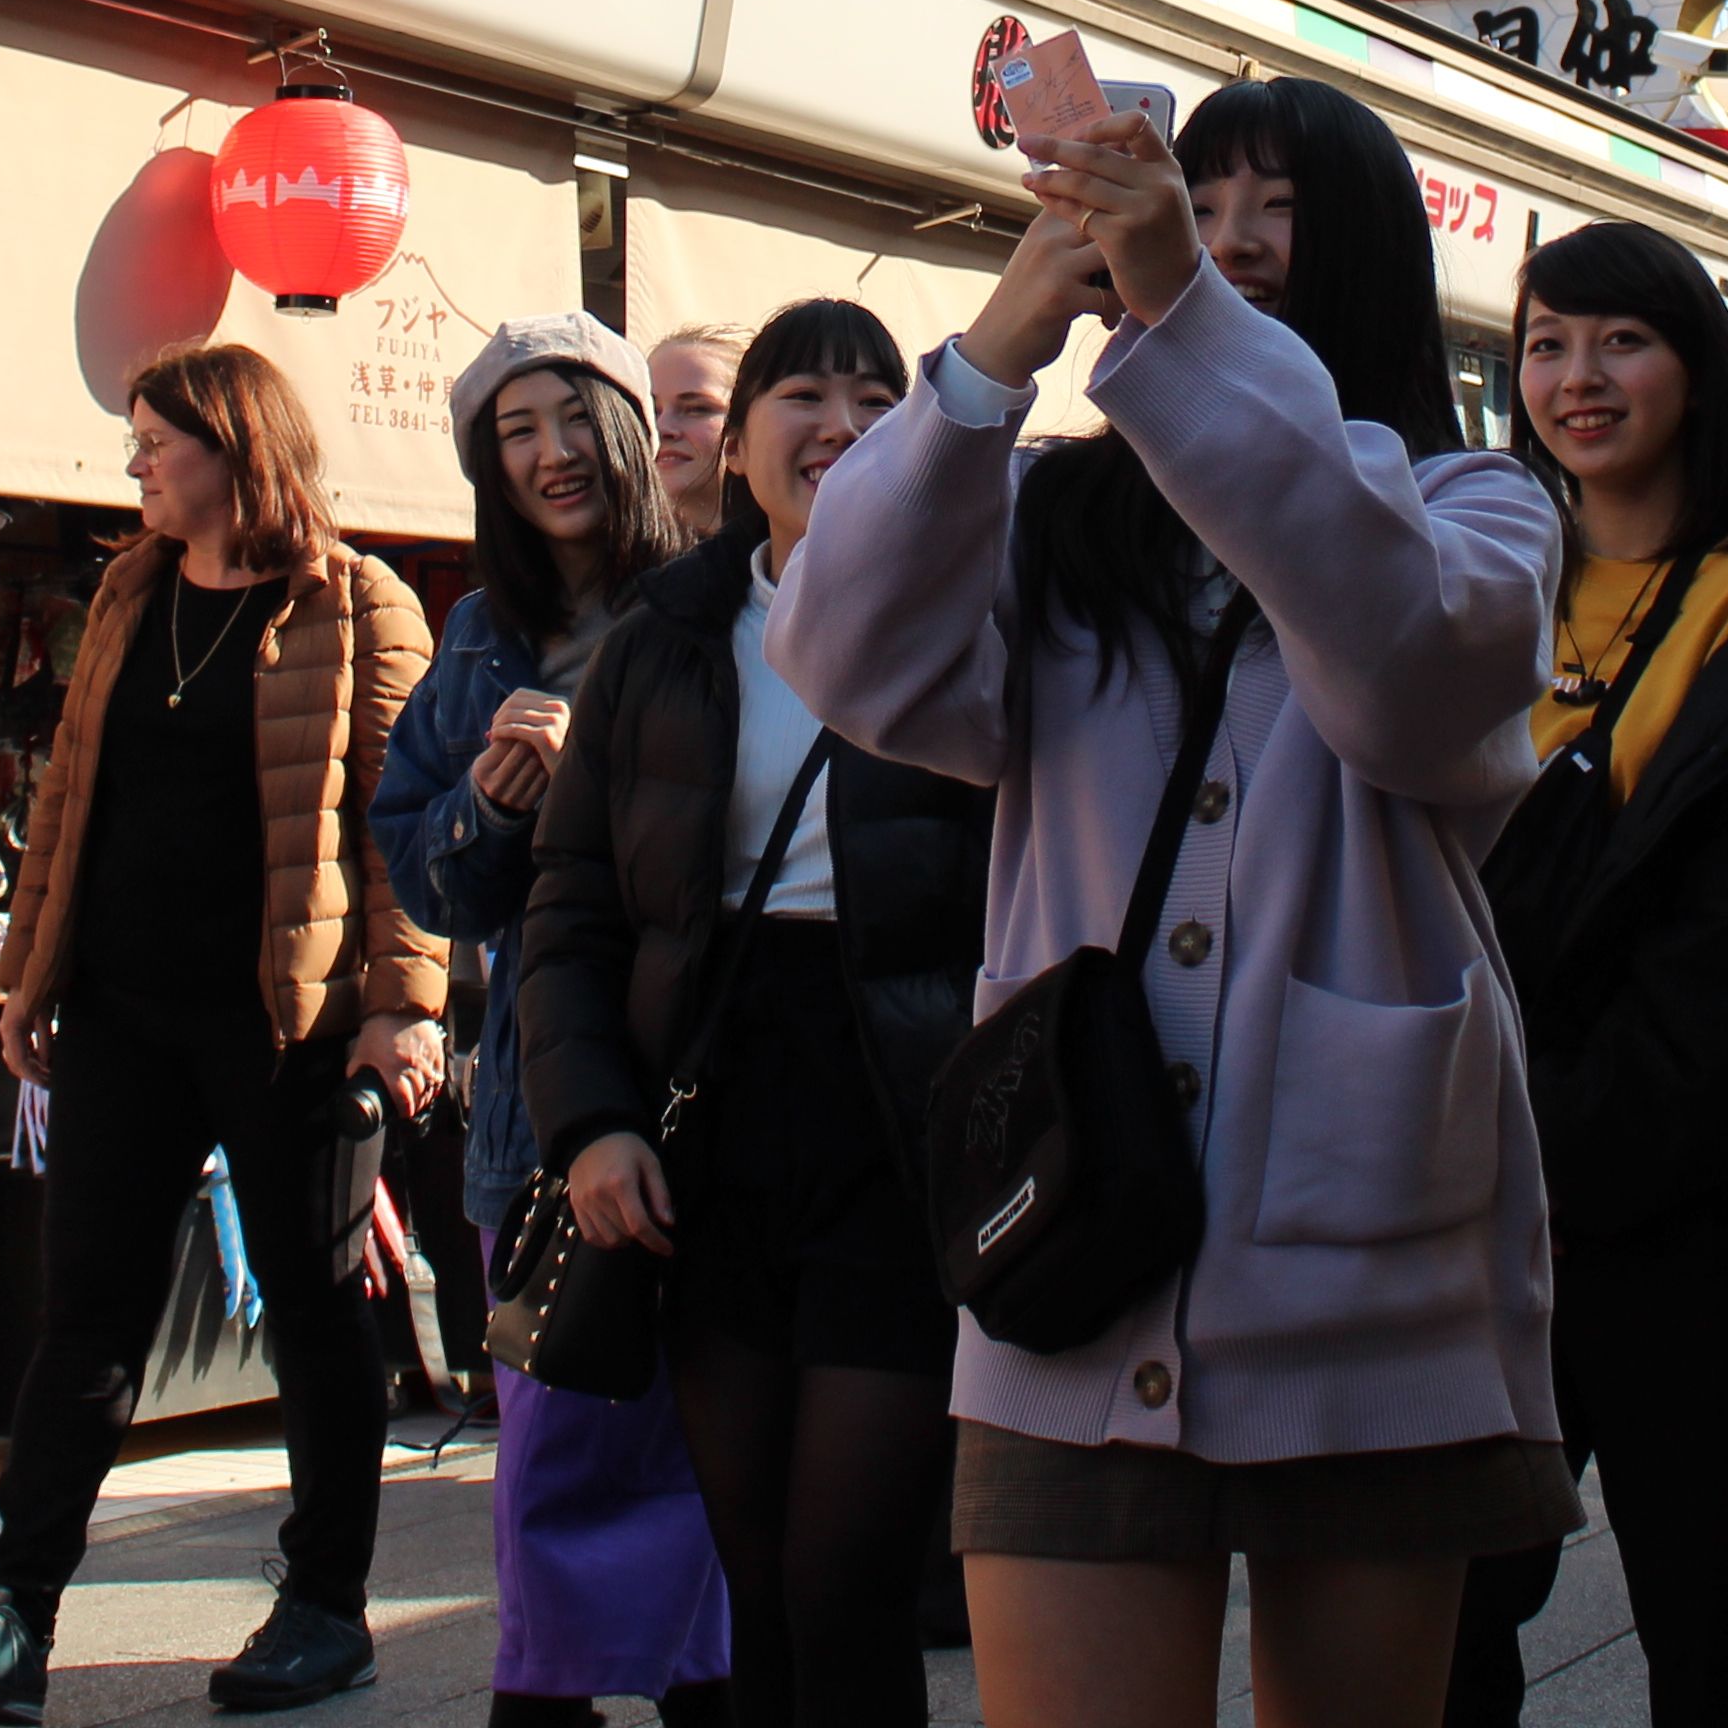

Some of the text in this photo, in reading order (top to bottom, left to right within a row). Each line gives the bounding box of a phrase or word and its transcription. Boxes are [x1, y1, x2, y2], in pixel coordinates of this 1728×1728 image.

[374, 295, 448, 340] フジヤ
[376, 336, 442, 363] FUJIYA
[349, 403, 384, 426] TEL
